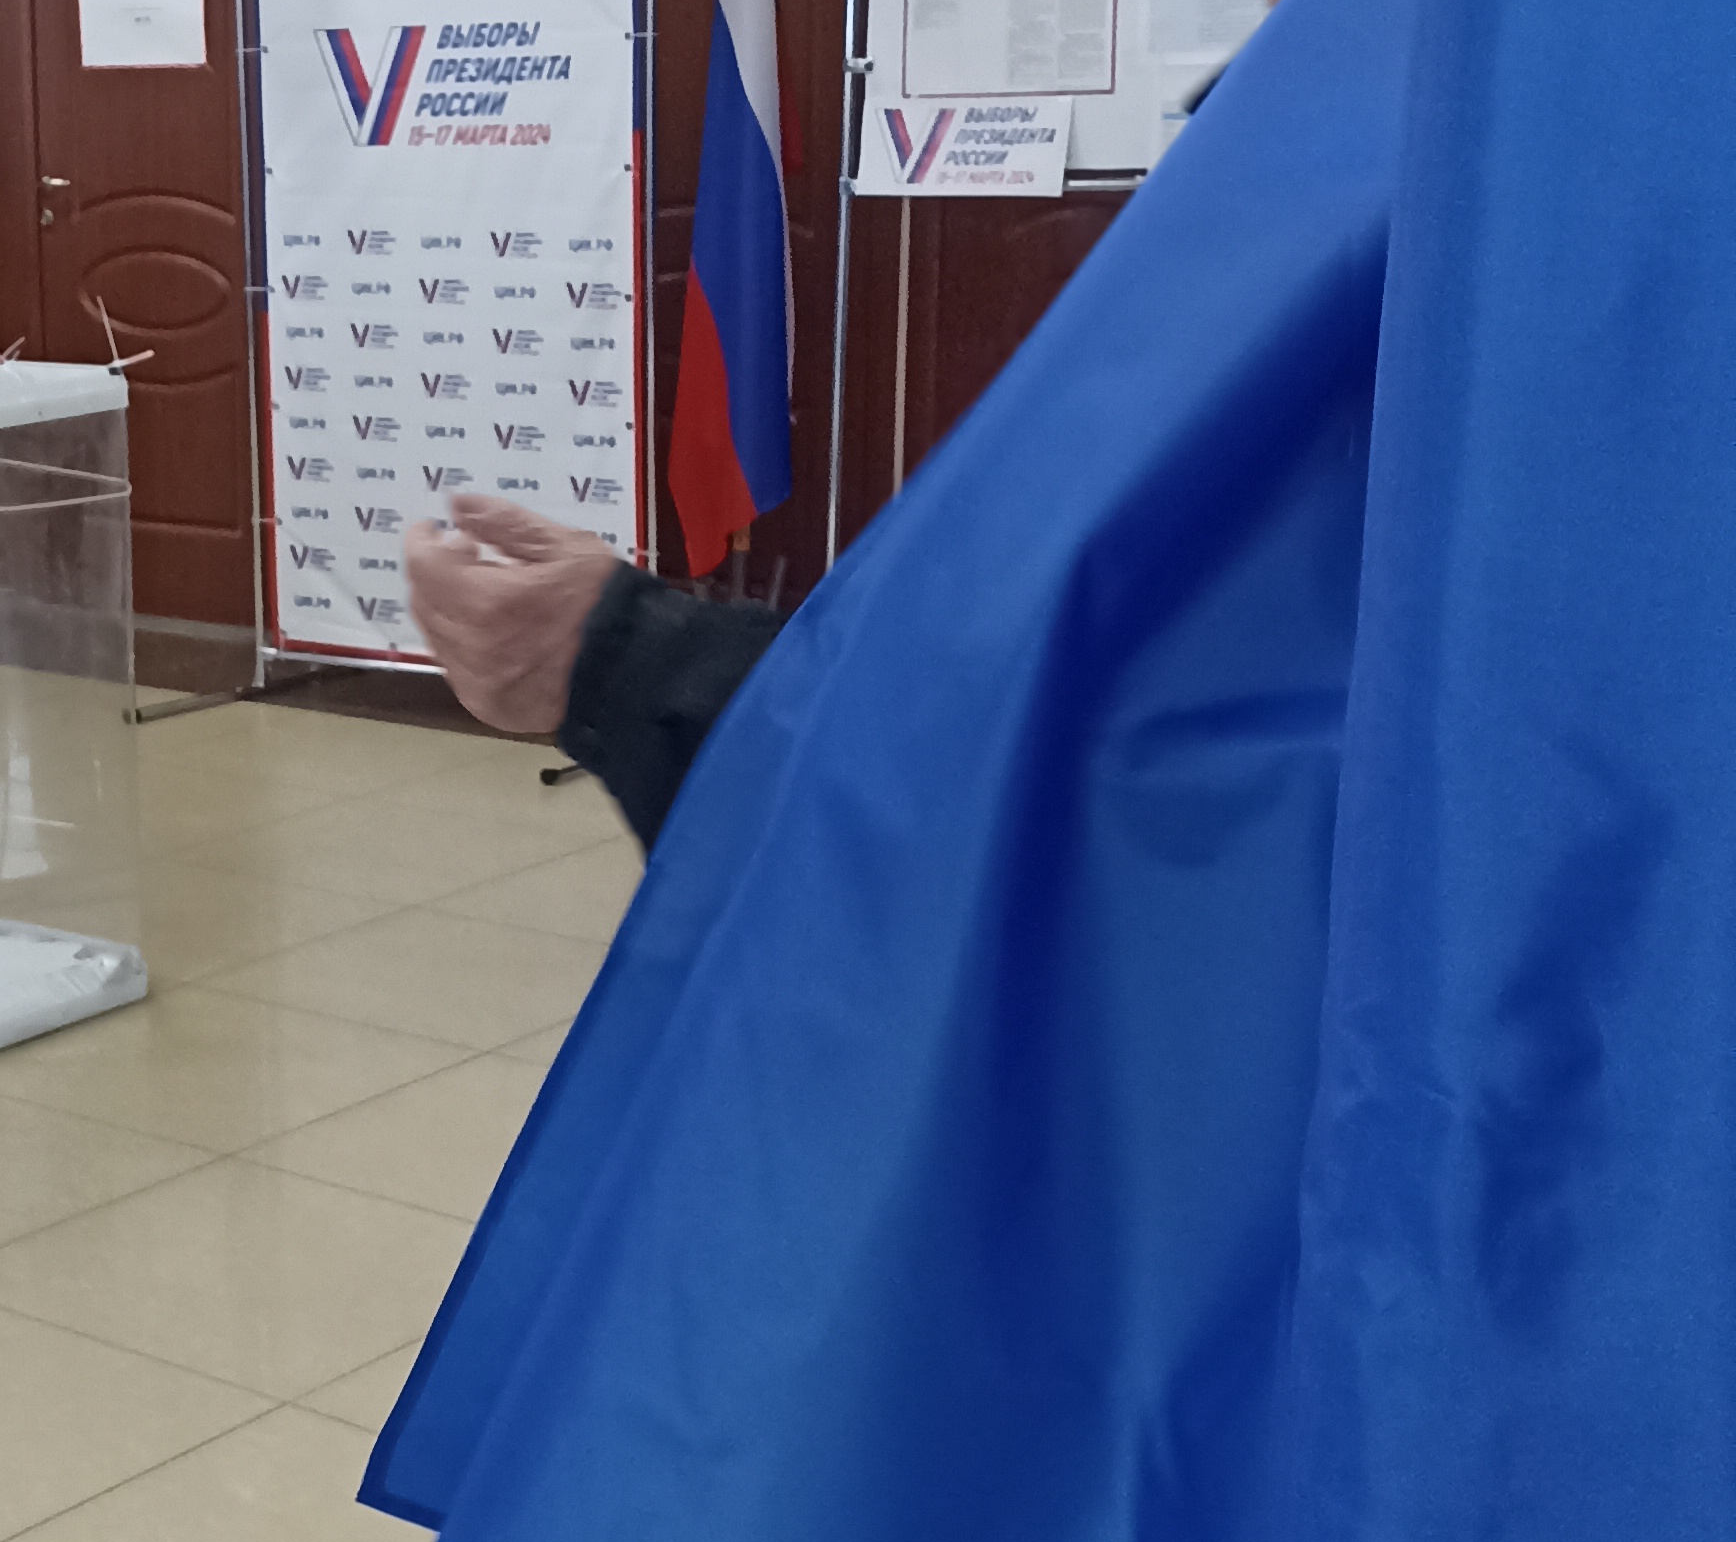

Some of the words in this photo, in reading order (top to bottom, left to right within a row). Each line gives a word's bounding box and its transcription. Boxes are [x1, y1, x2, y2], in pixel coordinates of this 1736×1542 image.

[437, 21, 541, 49] ВЫБОРЫ
[425, 55, 572, 85] ПРЕЗИДЕНТА
[415, 91, 509, 117] РОССИИ
